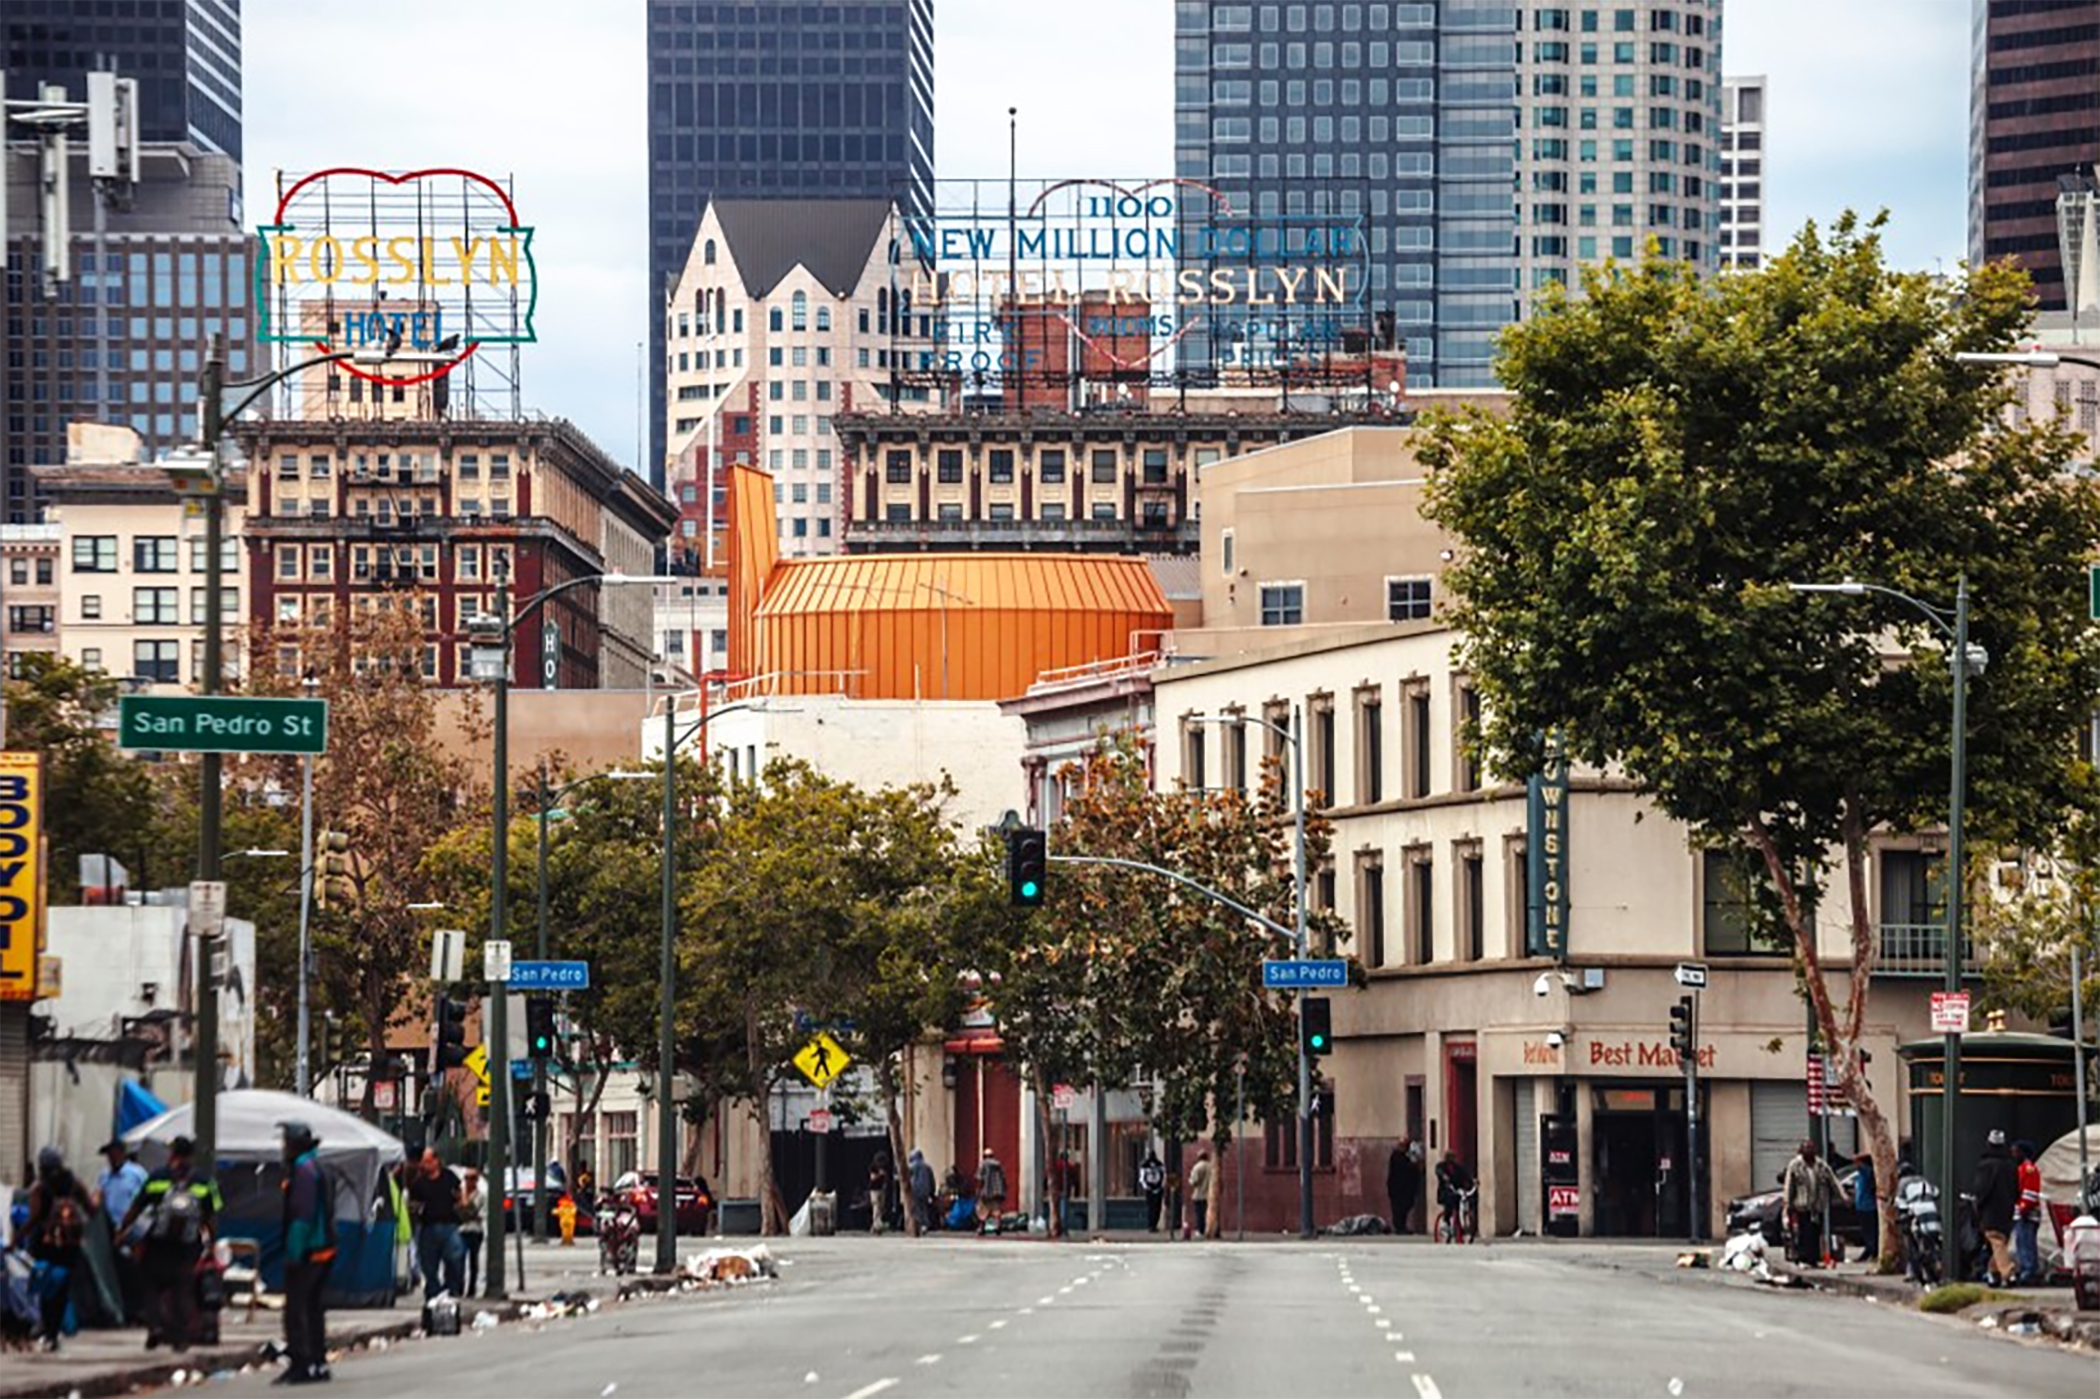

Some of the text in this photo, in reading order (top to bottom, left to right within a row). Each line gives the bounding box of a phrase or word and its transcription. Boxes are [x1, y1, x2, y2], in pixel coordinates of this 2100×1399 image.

[1089, 197, 1174, 217] 1100
[912, 227, 1352, 260] NEW MILLION DOLLAR
[271, 235, 518, 287] ROSSLYN
[911, 266, 1346, 304] HOTEL ROSSLYN
[933, 321, 1018, 344] FIRE
[1087, 314, 1173, 337] ROOMS
[920, 349, 1042, 372] PROOF
[134, 712, 313, 736] San Pedro St
[512, 966, 583, 982] San Pedro
[1270, 965, 1342, 981] San Pedro
[1590, 1041, 1718, 1068] Best Maet
